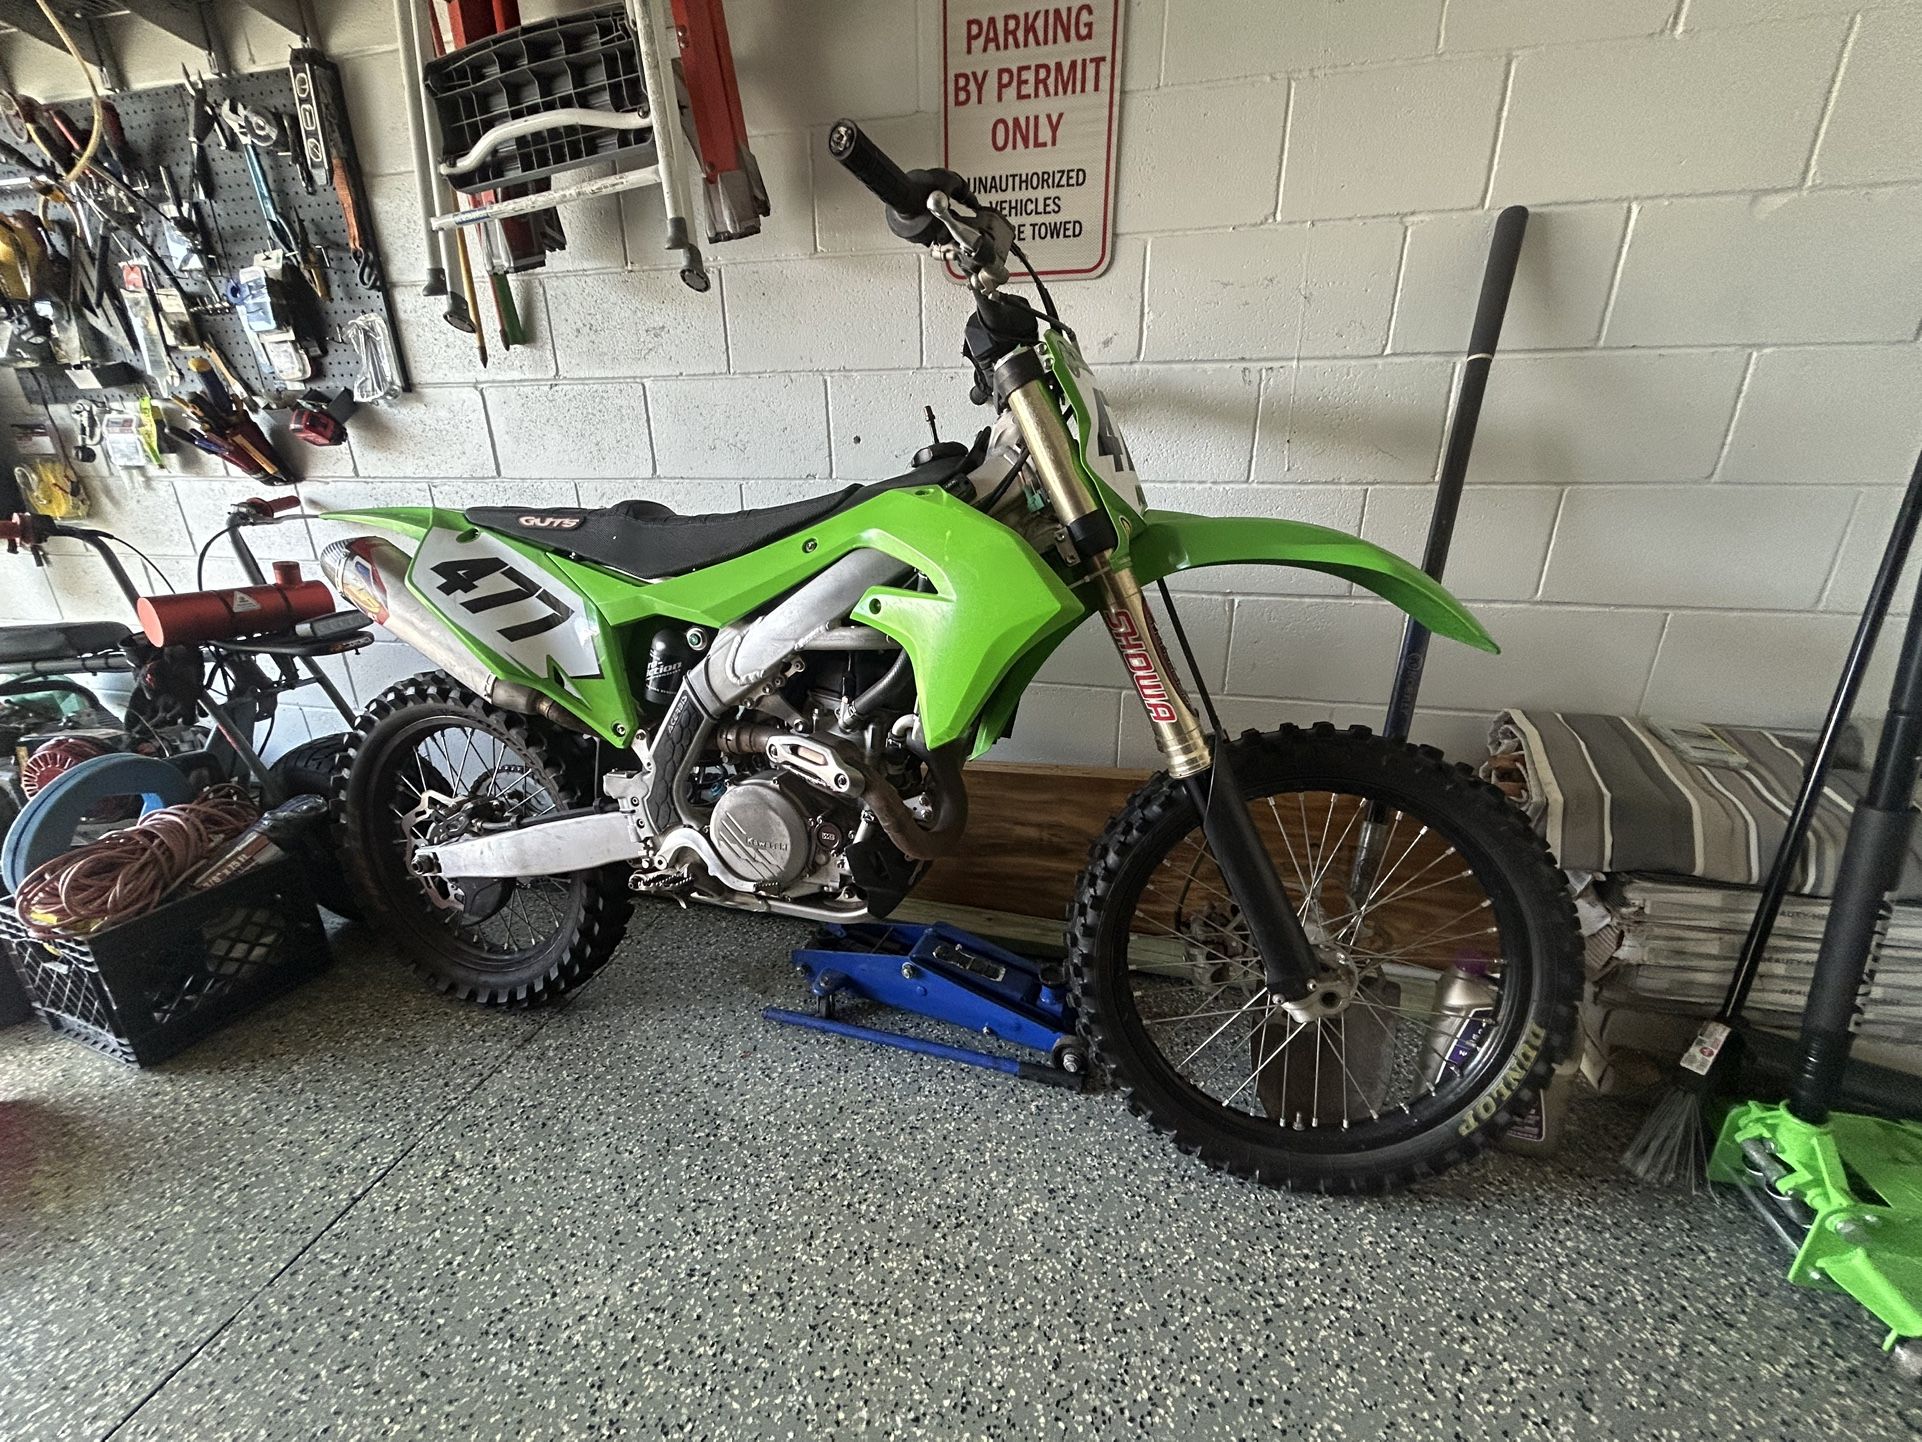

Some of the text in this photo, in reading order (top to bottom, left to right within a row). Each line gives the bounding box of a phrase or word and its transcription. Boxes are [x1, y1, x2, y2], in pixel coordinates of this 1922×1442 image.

[965, 3, 1095, 55] PARKING
[953, 56, 1107, 107] BY PERMIT
[990, 112, 1065, 153] ONLY
[968, 168, 1087, 195] UNAUTHORIZED
[1013, 220, 1083, 242] E TOWED
[518, 515, 580, 528] GUTS
[429, 556, 575, 643] 477
[1103, 608, 1179, 724] SHOWA
[1457, 1019, 1547, 1137] DUNLOP
